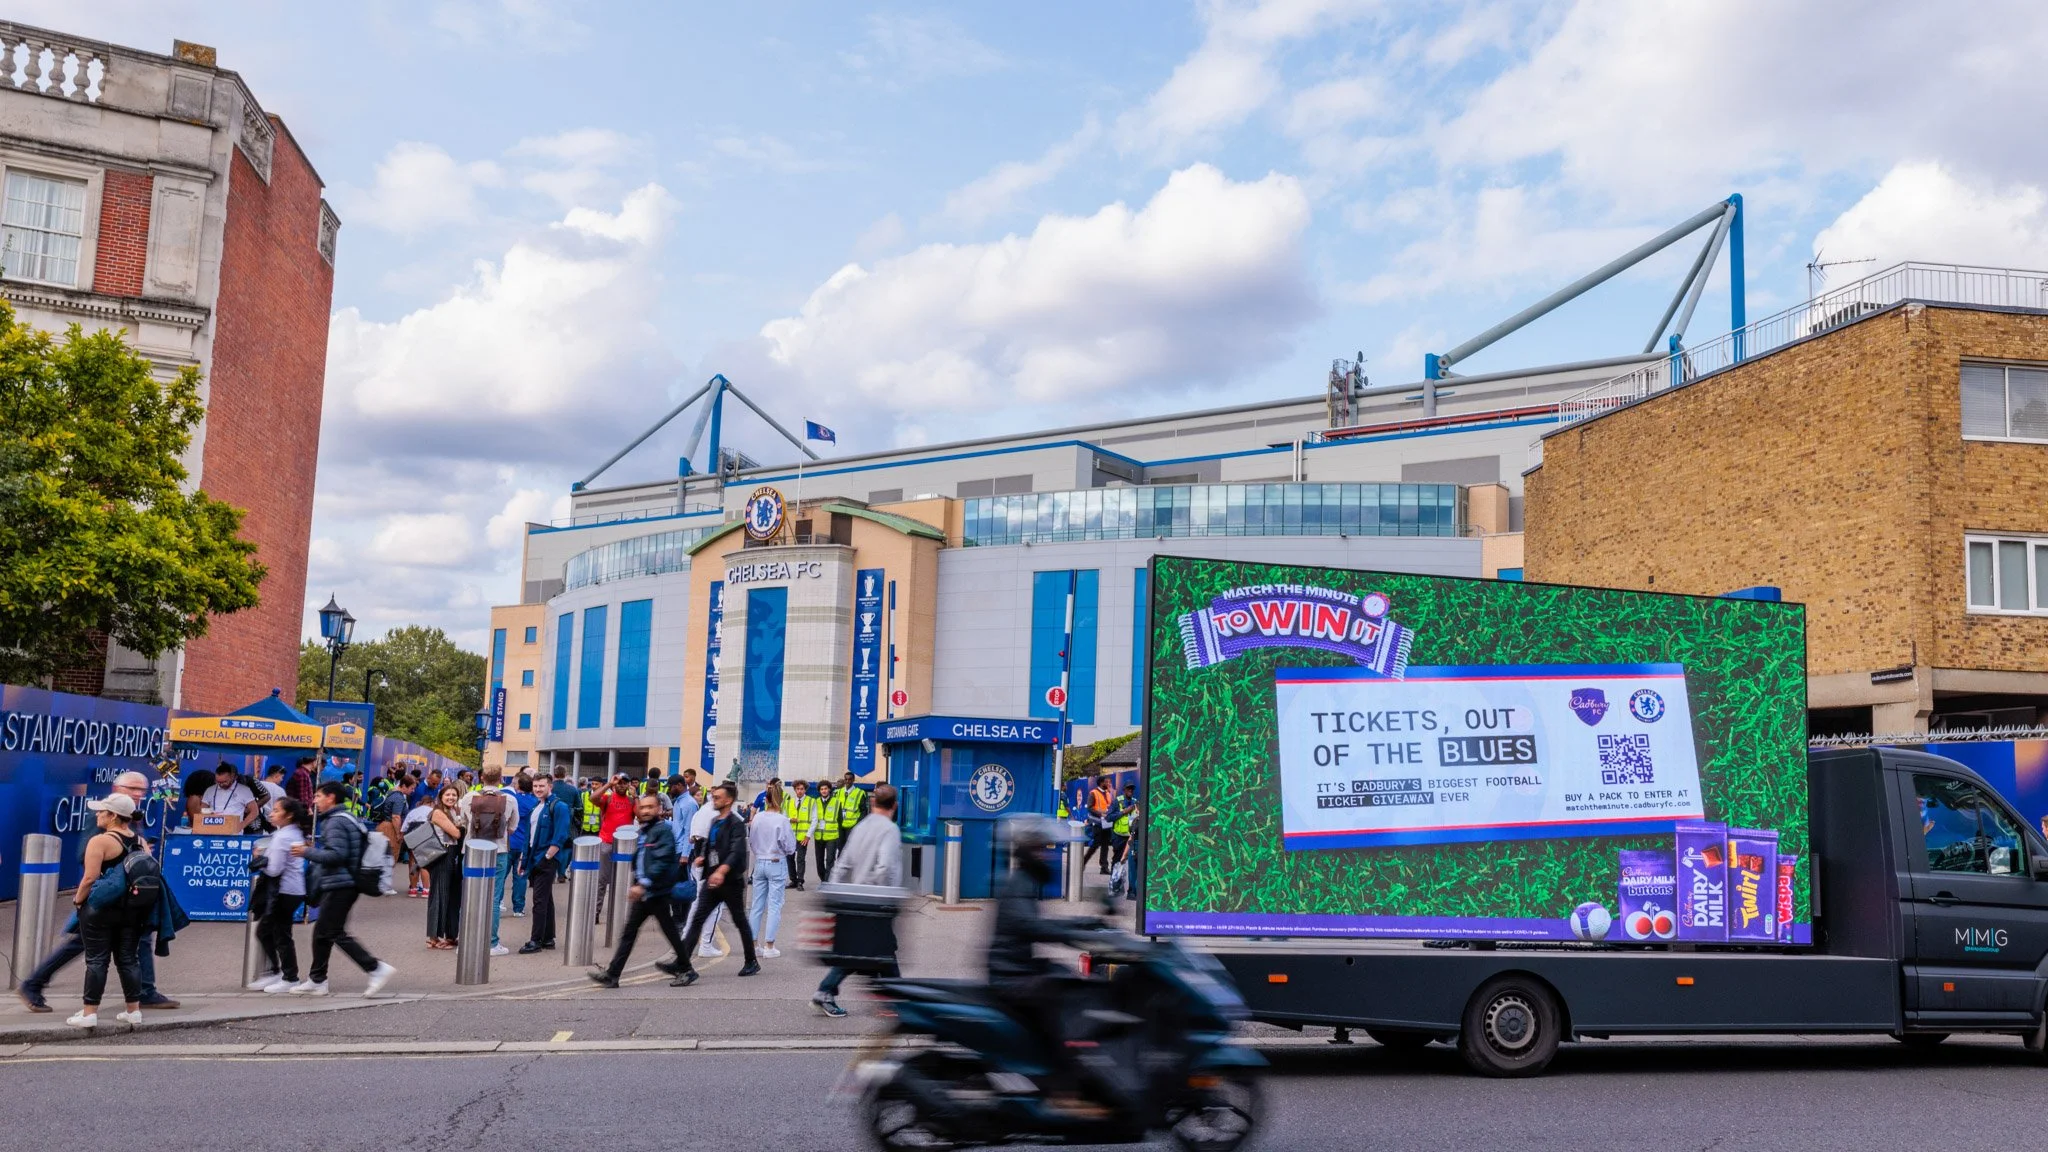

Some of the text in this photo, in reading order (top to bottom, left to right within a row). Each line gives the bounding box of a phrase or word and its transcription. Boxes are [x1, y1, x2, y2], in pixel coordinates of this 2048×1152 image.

[751, 487, 777, 501] CHELSEA
[728, 560, 822, 585] CHELSEA FC
[1223, 583, 1359, 606] MATCH THE MINUTE
[1212, 600, 1381, 642] TO WIN IT
[1568, 696, 1610, 712] Cadbury
[907, 723, 920, 737] GATE
[1310, 708, 1516, 735] TICKETS, OUT
[4, 712, 111, 756] STAMFORD
[179, 728, 313, 744] OFFICIAL PROGRAMMES
[952, 723, 1042, 740] CHELSEA FC
[1313, 738, 1533, 767] OF THE BLUES
[95, 767, 118, 784] HOME
[978, 764, 1008, 777] CHELSEA
[1316, 775, 1542, 793] IT'S CADBURY'S BIGGEST FOOTBALL
[1319, 792, 1470, 807] TICKET GIVEAWAY EVER
[1565, 790, 1689, 802] BUY A PACK TO ENTER AT
[1566, 800, 1691, 812] matchtheminute.cadburyfc.com
[204, 816, 224, 824] £4.00
[188, 879, 203, 887] ON
[205, 879, 229, 887] SALE
[1623, 875, 1676, 886] DAIRY MILK
[1628, 885, 1674, 896] buttons
[1693, 868, 1709, 927] DAIRY
[1736, 869, 1761, 929] Twirl
[1709, 880, 1724, 927] MILK
[1777, 875, 1794, 925] Wispa
